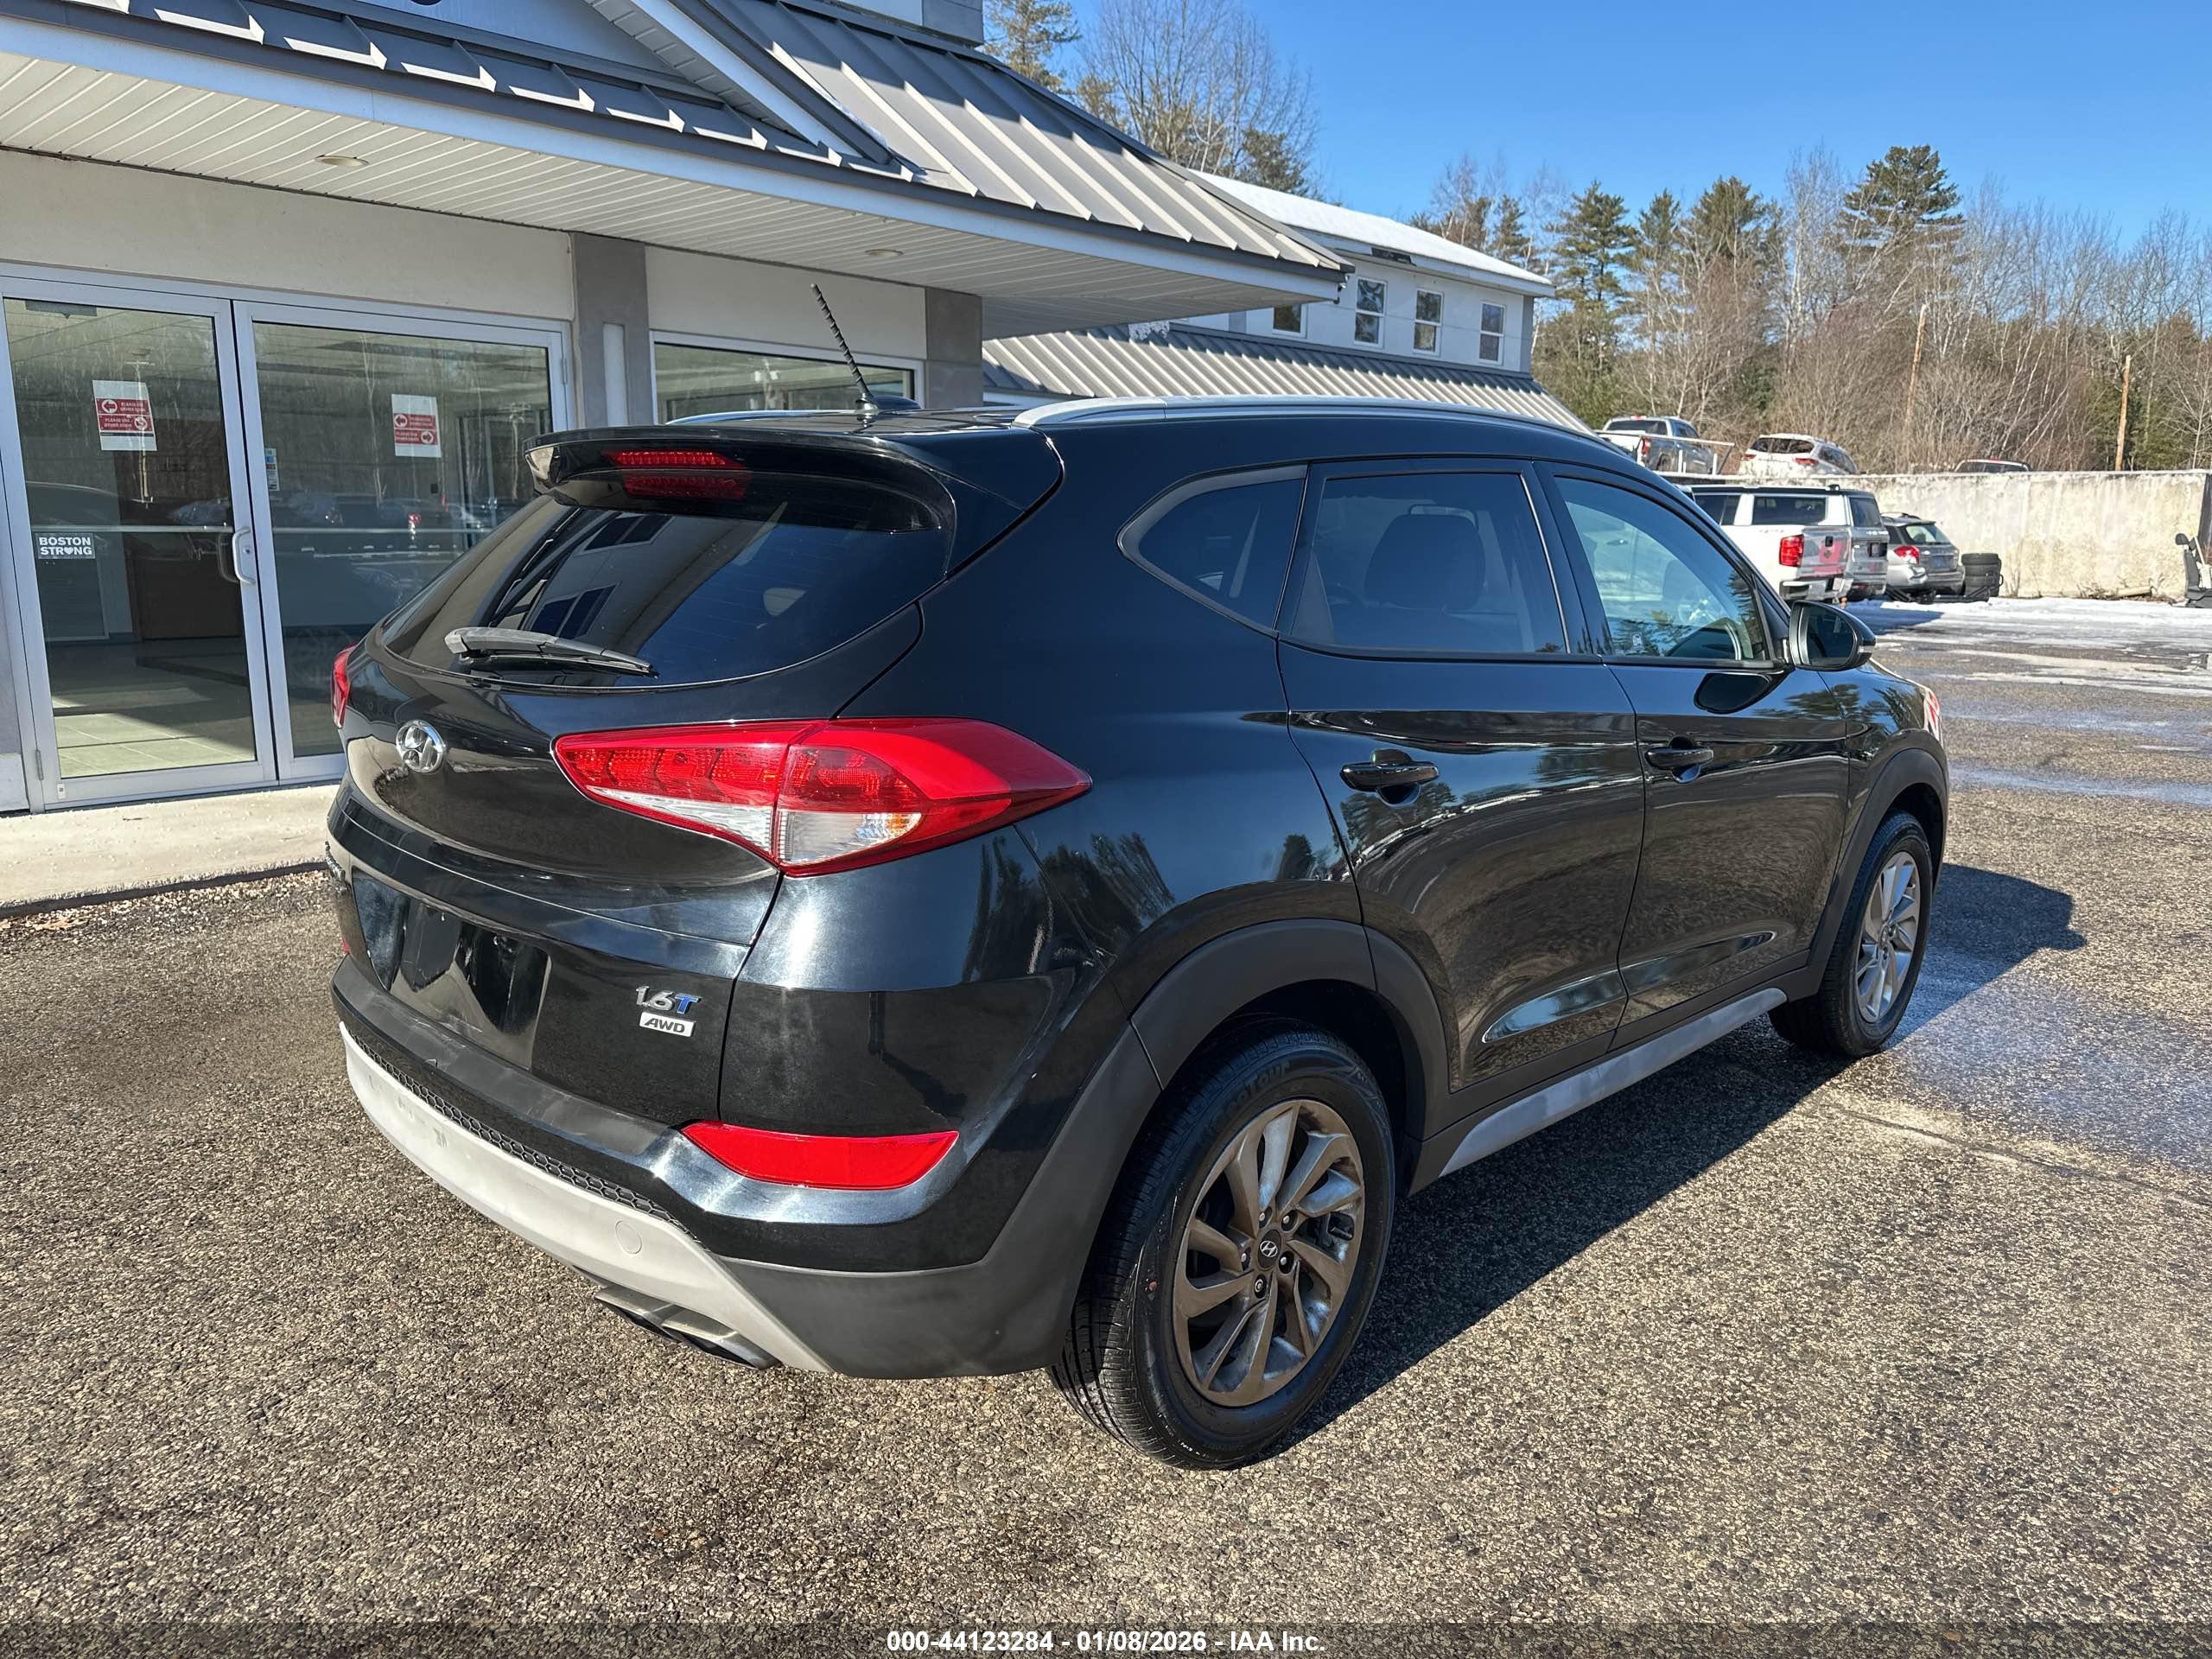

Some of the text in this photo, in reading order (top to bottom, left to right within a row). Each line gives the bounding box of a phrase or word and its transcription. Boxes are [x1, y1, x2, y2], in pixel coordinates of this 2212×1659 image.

[39, 537, 91, 545] BOSTON
[636, 986, 699, 1014] 1.6T
[645, 1018, 685, 1033] AWD
